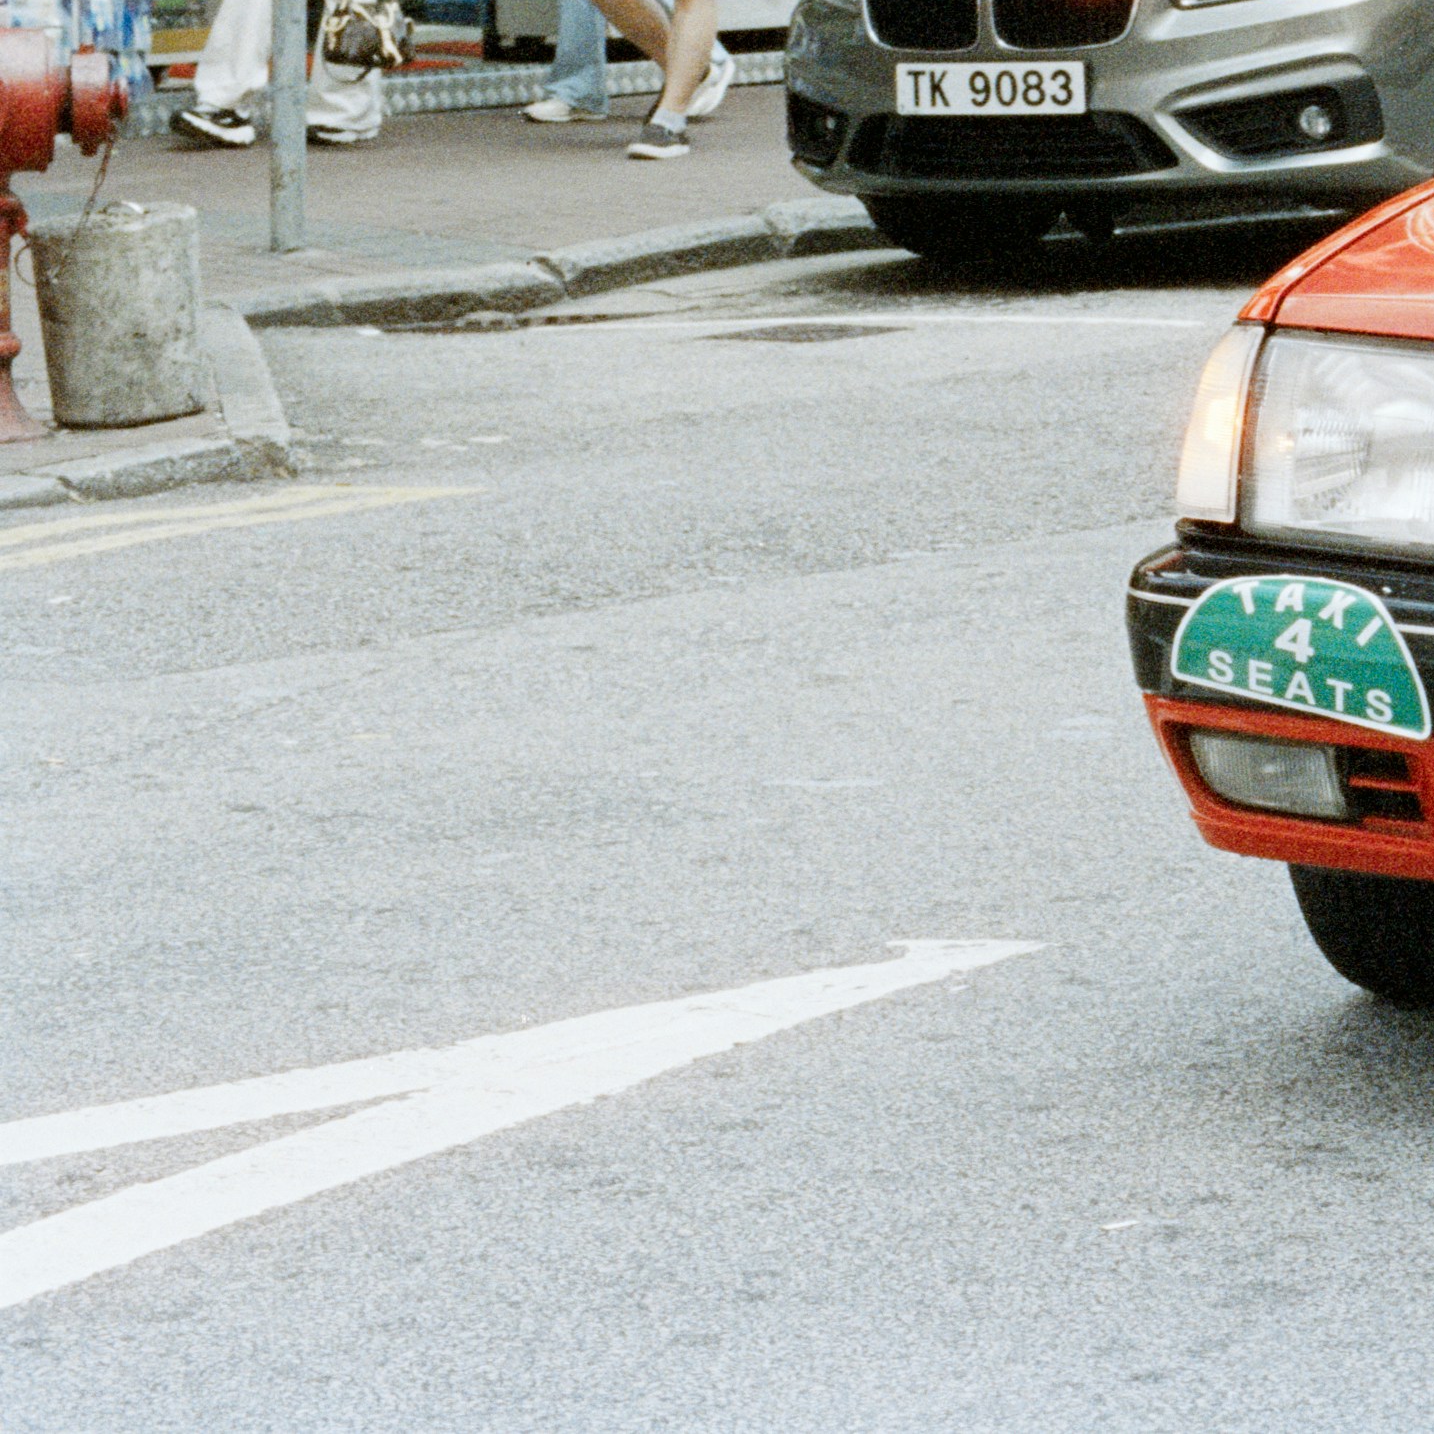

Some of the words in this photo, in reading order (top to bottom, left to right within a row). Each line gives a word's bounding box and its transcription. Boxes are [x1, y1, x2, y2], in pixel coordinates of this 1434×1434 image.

[907, 70, 950, 107] TK
[969, 69, 1074, 107] 9083
[1232, 580, 1384, 647] TAXI
[1274, 617, 1315, 664] 4
[1207, 649, 1394, 724] SEATS
